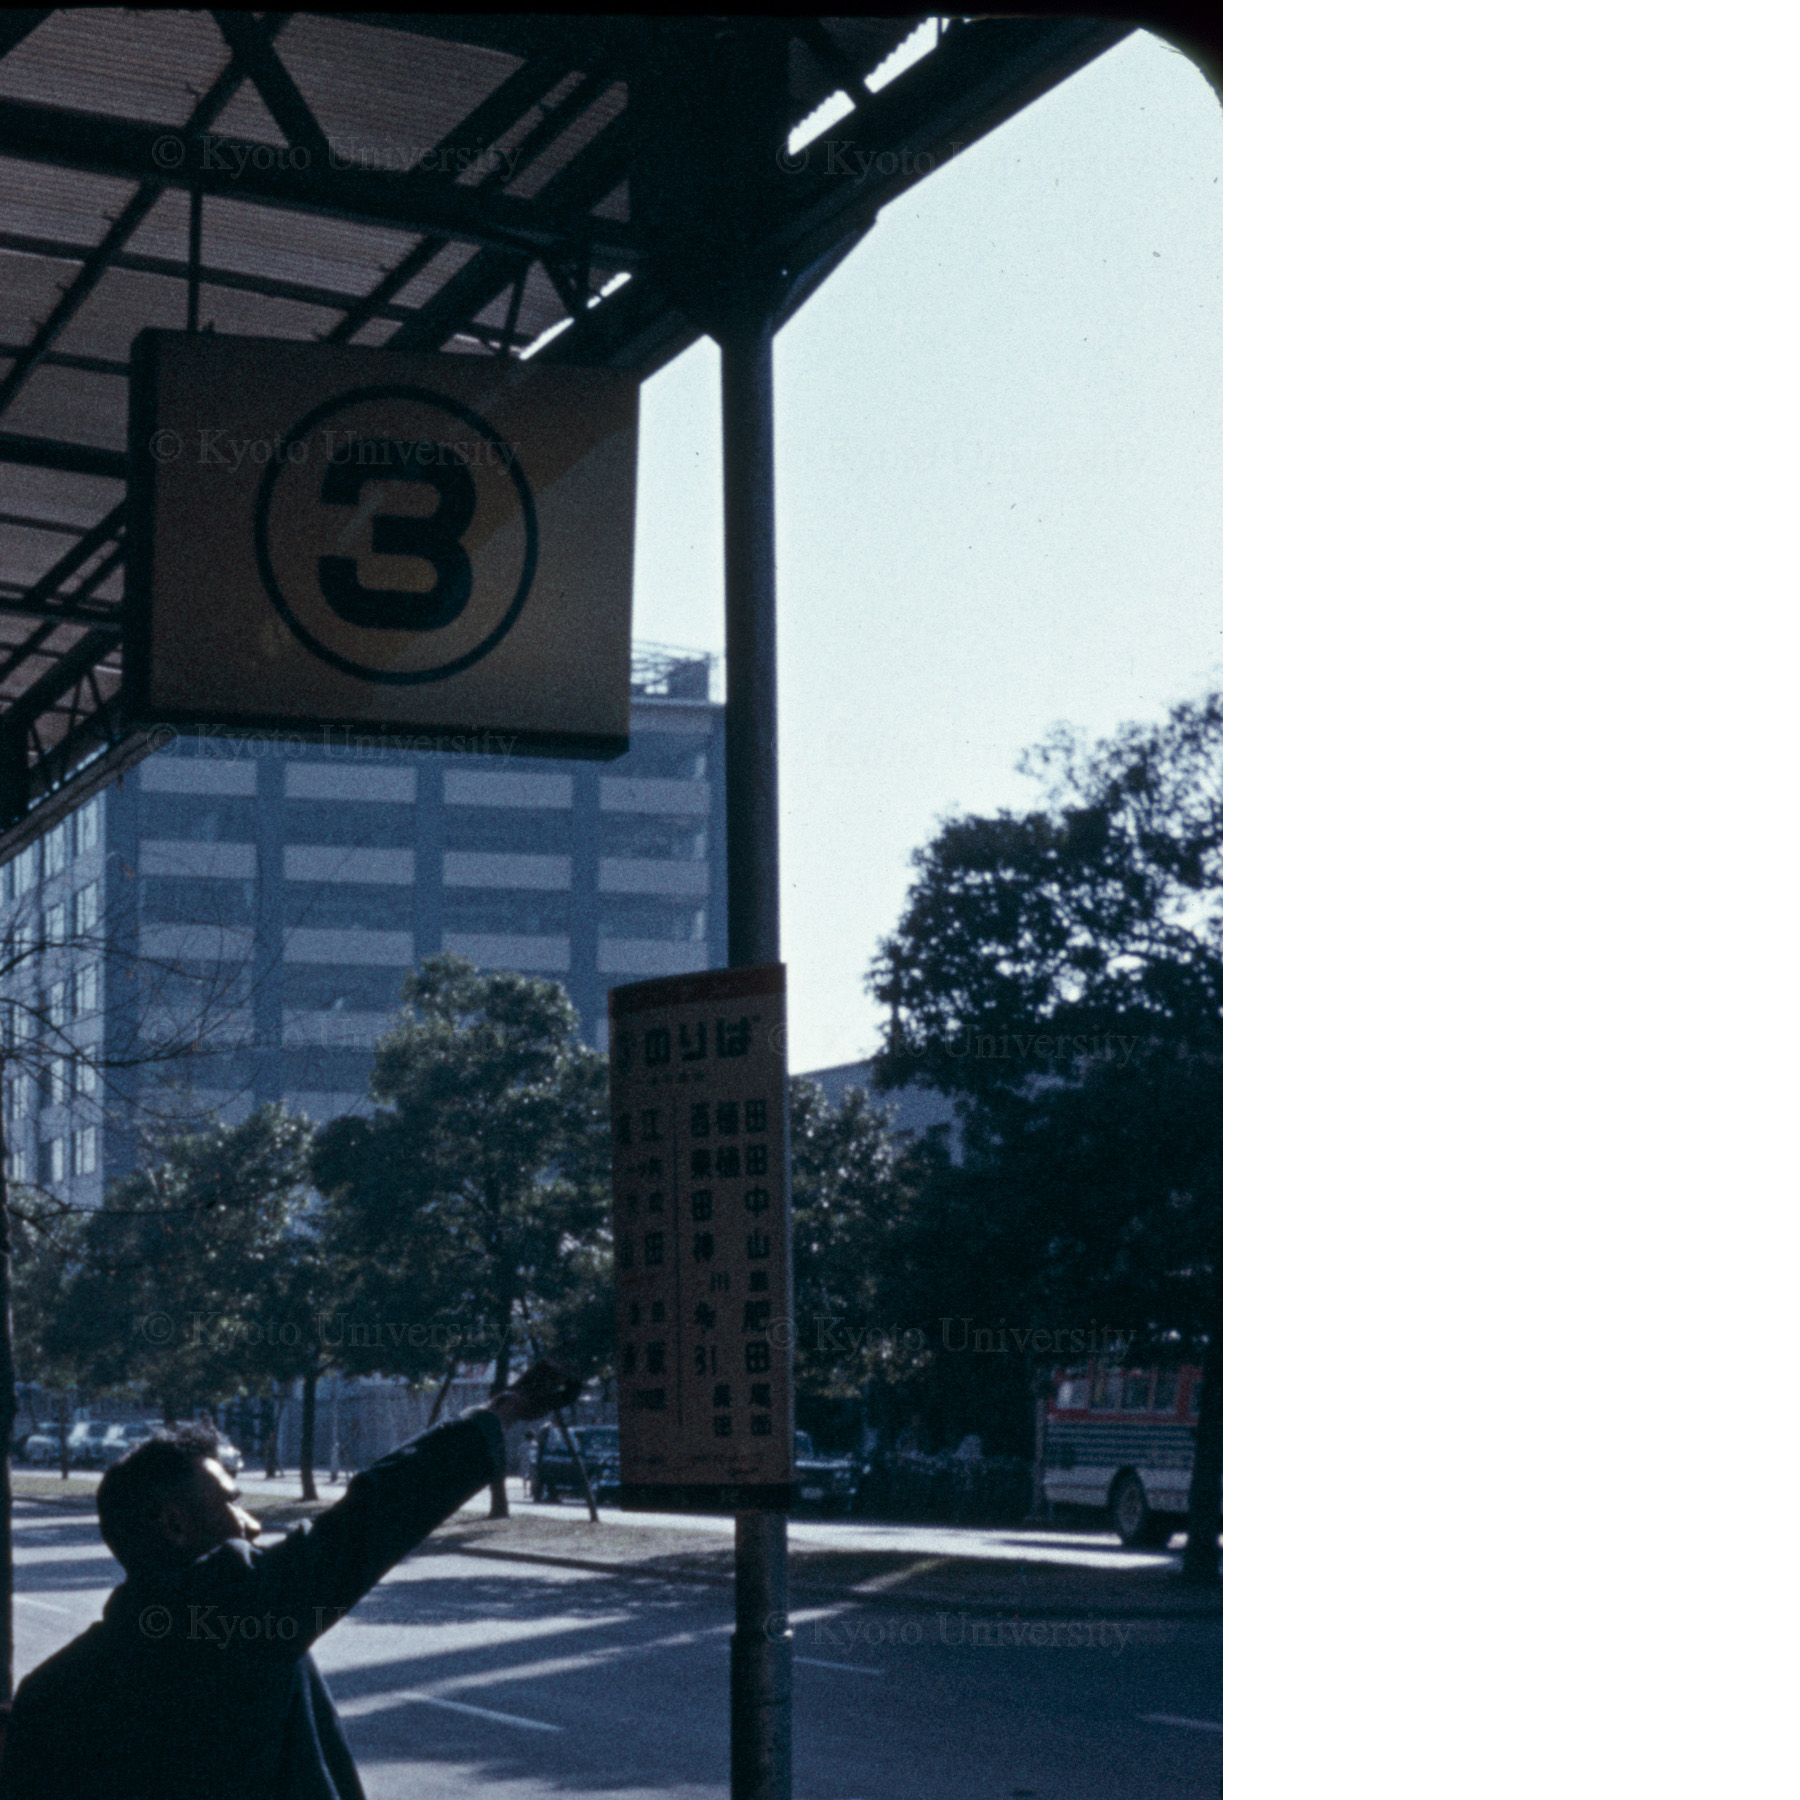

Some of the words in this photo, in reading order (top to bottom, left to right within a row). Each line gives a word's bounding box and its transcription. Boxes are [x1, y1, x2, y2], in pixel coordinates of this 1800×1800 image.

[318, 438, 477, 629] 3
[644, 1015, 761, 1067] のりば
[691, 1186, 770, 1222] 田中
